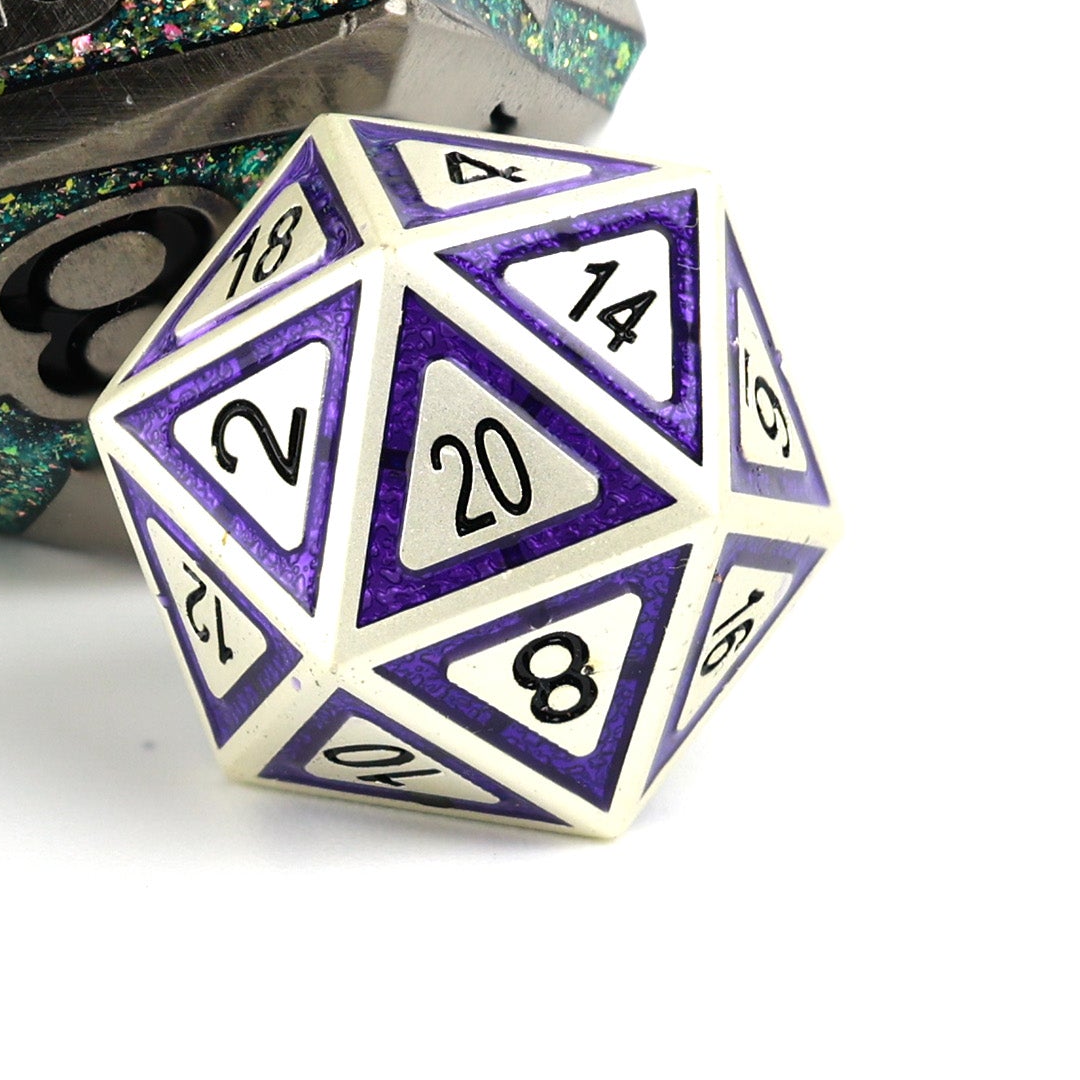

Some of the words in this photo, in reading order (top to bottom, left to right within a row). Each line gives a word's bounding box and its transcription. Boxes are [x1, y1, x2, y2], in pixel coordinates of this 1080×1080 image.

[444, 150, 527, 185] 4
[225, 206, 303, 301] 18
[568, 259, 658, 353] 14
[210, 398, 308, 487] 2
[430, 417, 533, 537] 20
[182, 561, 234, 665] 12
[700, 588, 765, 677] 16
[511, 631, 598, 724] 8
[323, 744, 443, 788] 10
